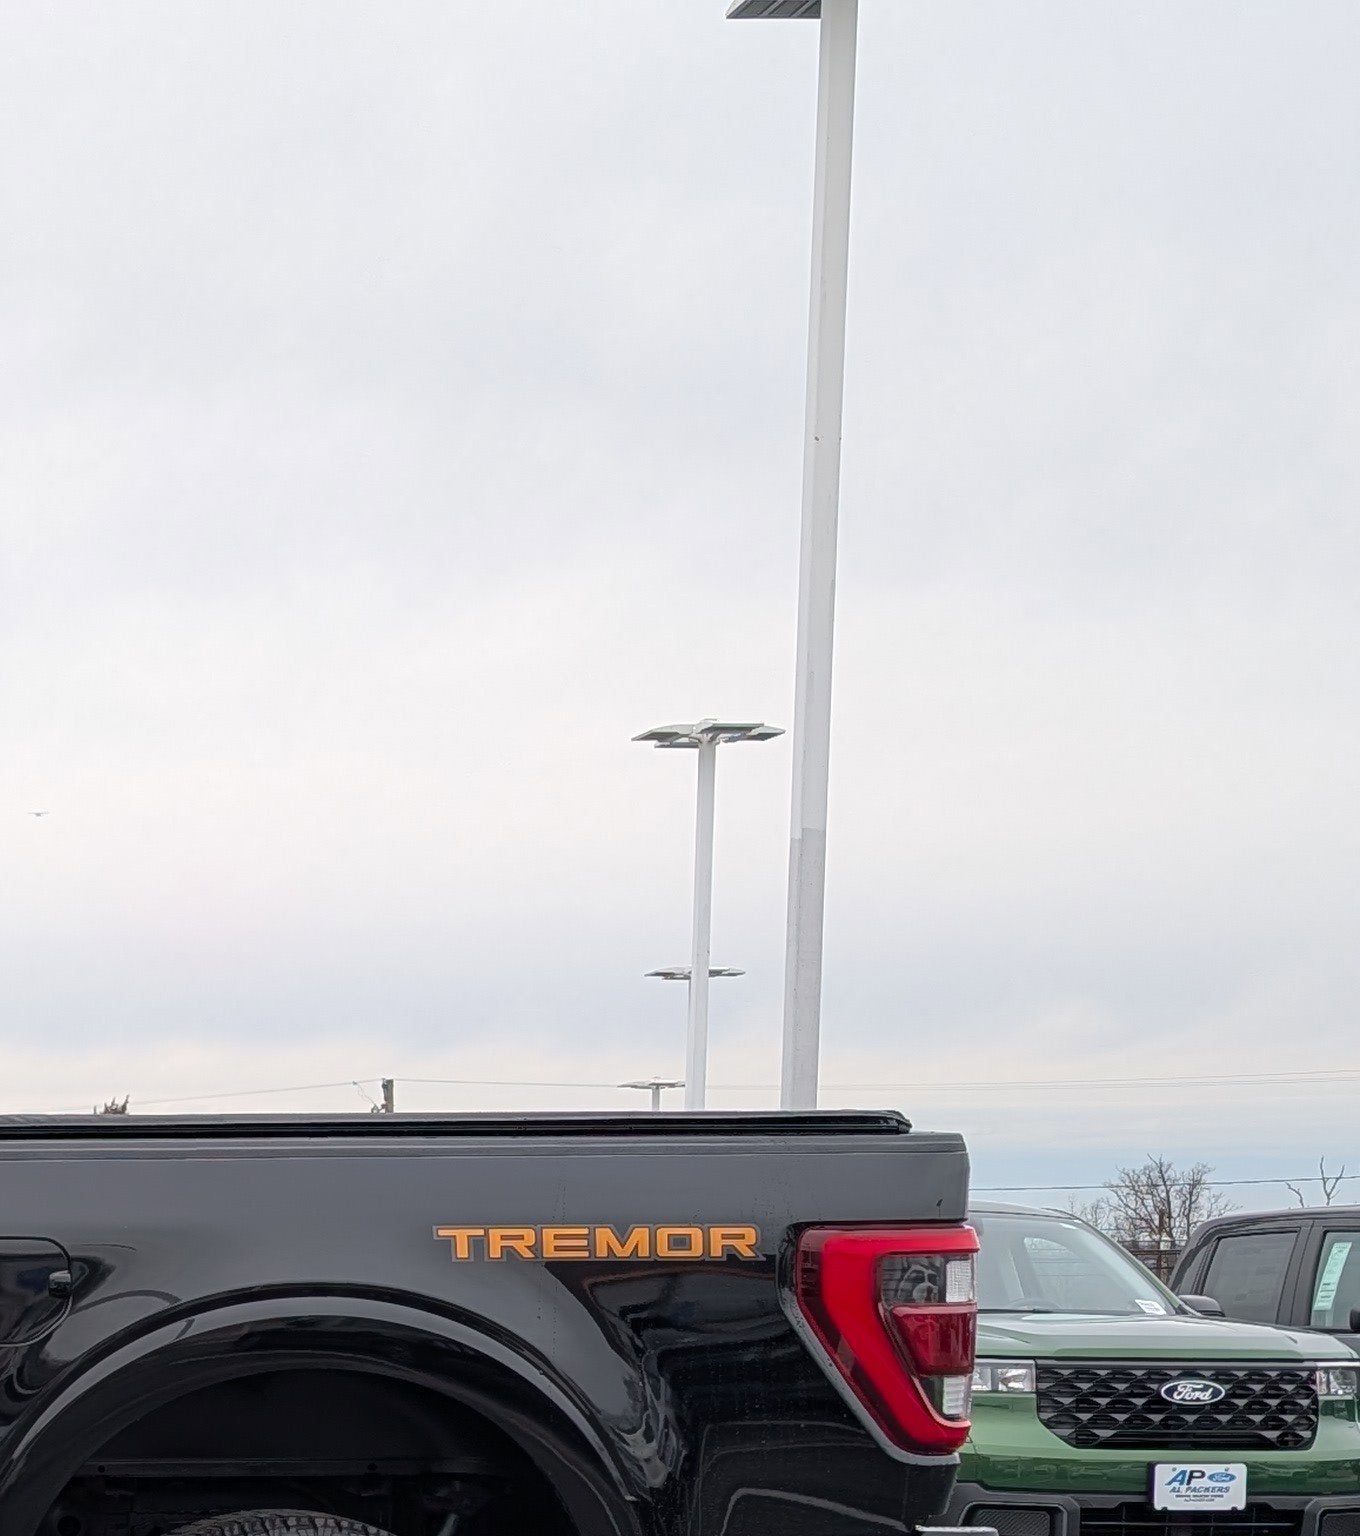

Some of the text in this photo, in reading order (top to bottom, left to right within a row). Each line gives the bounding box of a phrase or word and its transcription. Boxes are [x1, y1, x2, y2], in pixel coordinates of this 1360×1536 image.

[436, 1226, 758, 1260] TREMOR
[1173, 1383, 1214, 1400] Ford
[1165, 1469, 1206, 1486] AP
